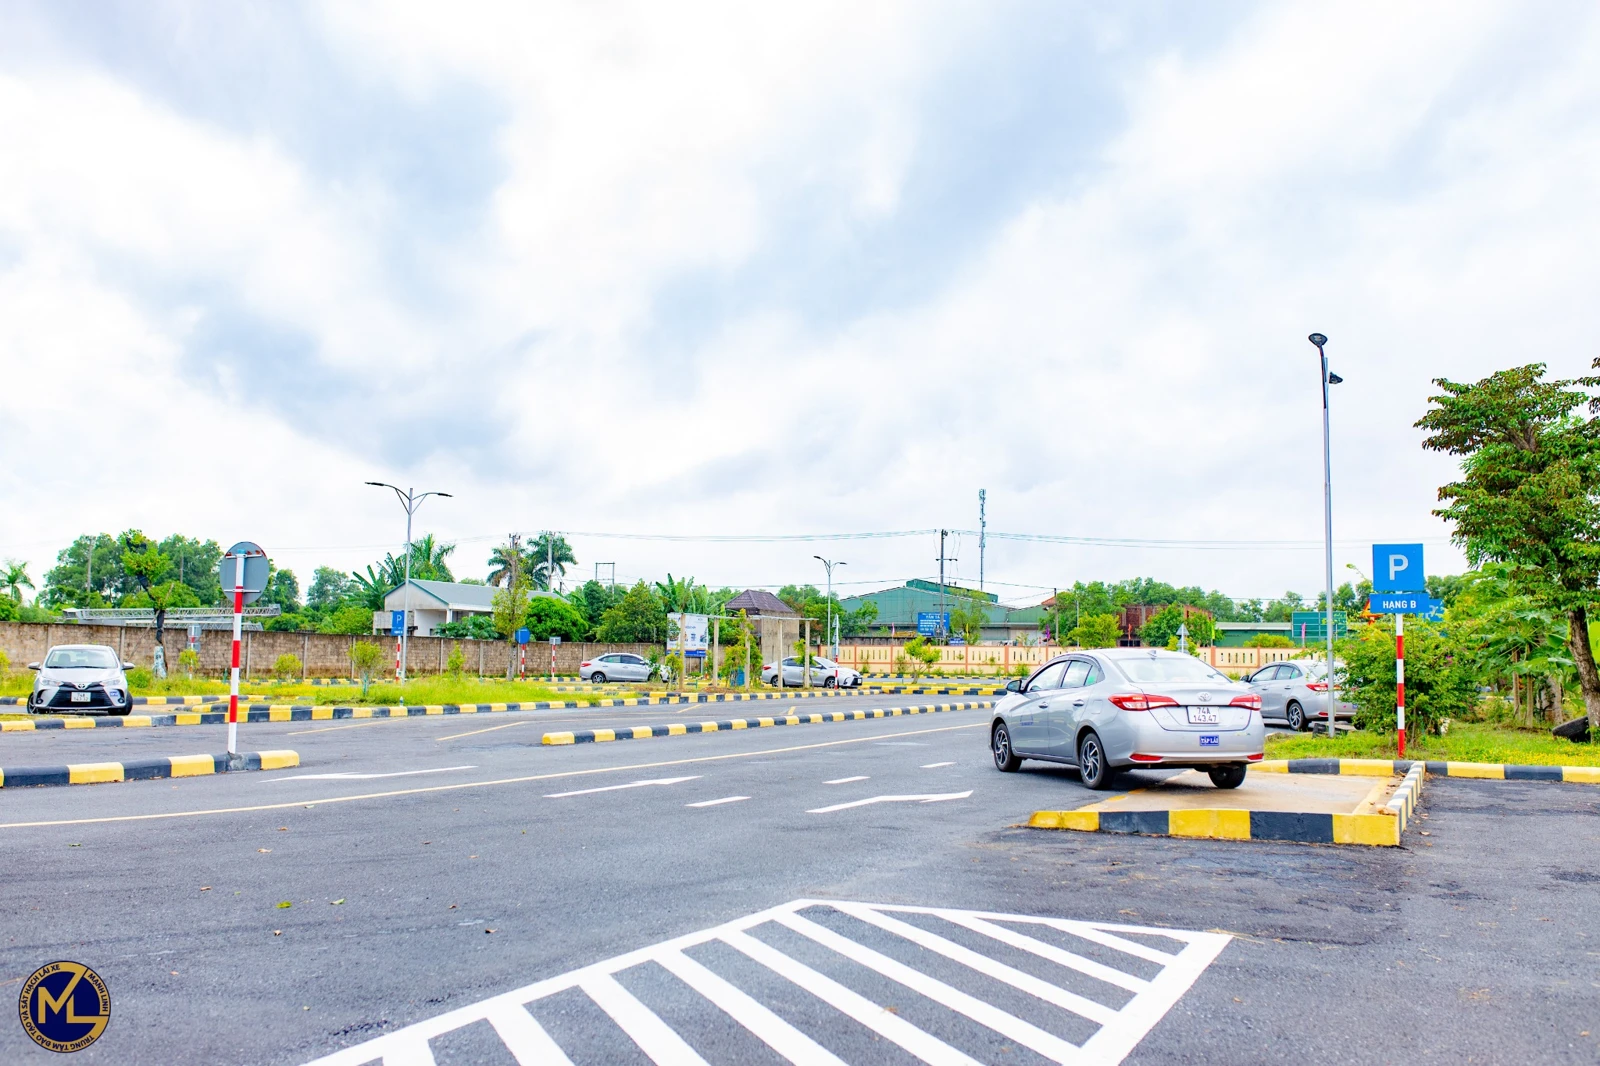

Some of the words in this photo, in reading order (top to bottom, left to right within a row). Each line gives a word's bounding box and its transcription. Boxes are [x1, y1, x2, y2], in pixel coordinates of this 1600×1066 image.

[1389, 554, 1409, 580] P
[1382, 600, 1407, 611] HẠNG
[1410, 600, 1417, 608] B
[396, 614, 402, 624] P
